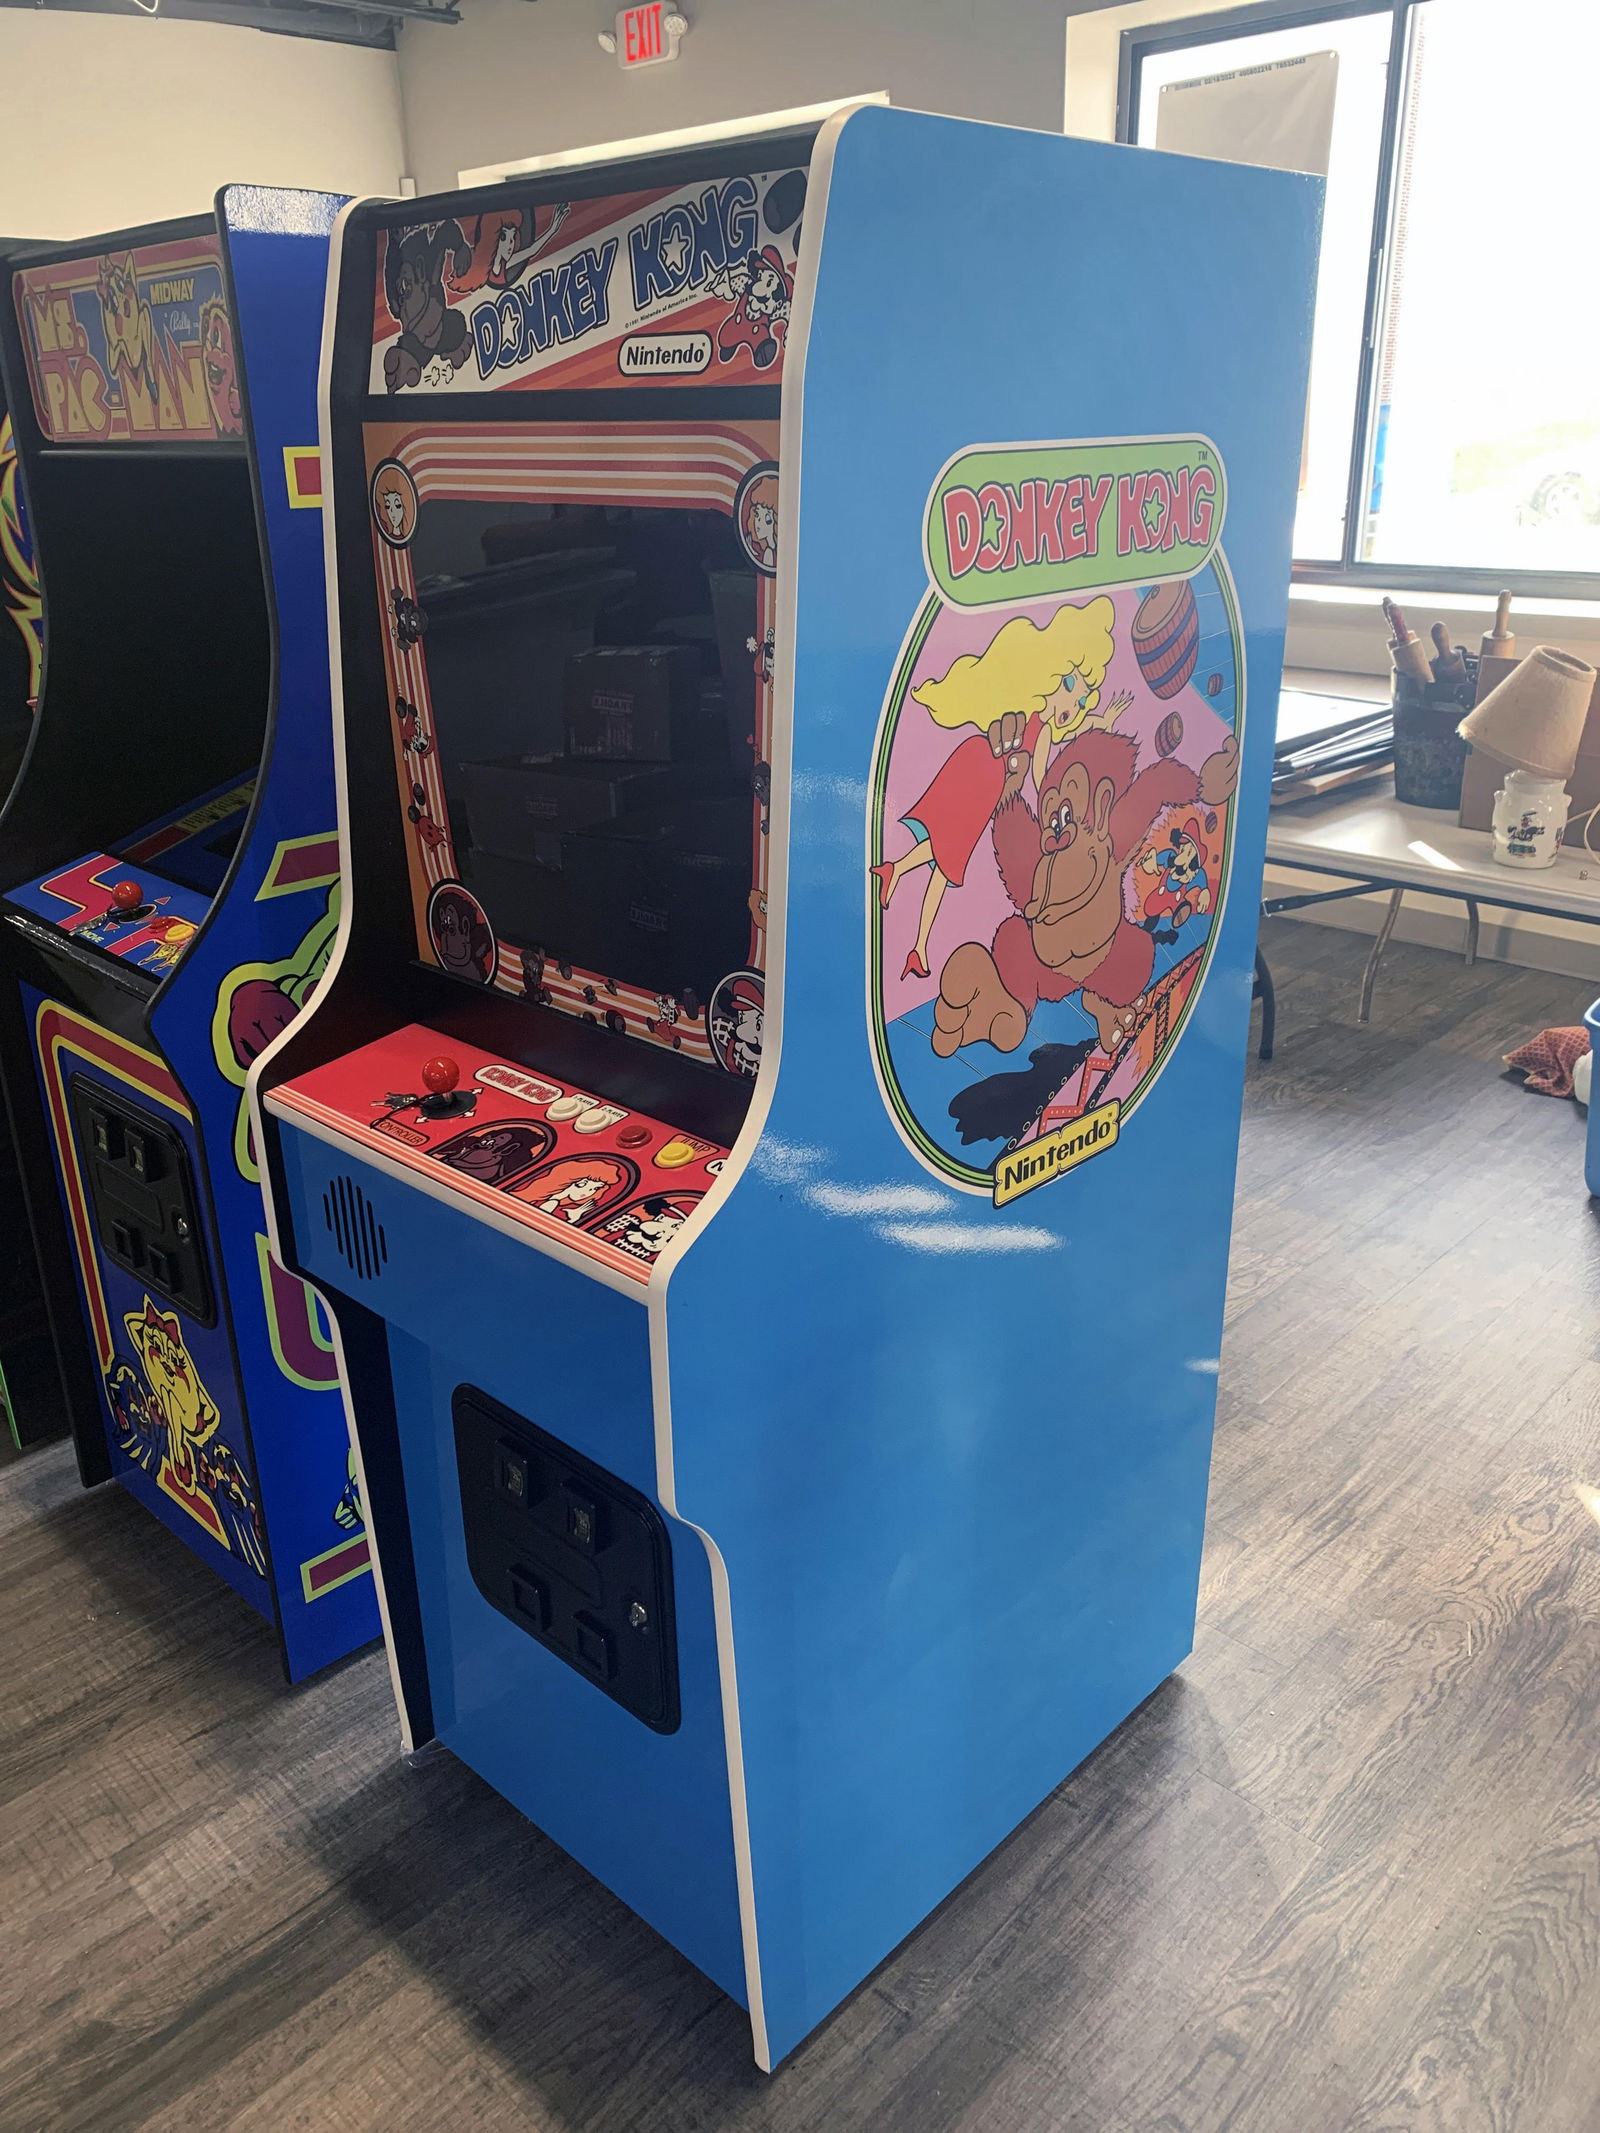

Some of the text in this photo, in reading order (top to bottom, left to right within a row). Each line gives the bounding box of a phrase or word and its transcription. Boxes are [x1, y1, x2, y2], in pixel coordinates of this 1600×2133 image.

[624, 4, 662, 62] EXIT
[149, 278, 195, 306] MIDWAY
[471, 236, 618, 380] DONKEY
[628, 176, 757, 311] KONG
[626, 342, 705, 366] Nintendo
[44, 352, 211, 434] PAC-MAN
[941, 475, 1114, 580] DONKEY
[1117, 464, 1217, 557] KONG
[378, 1121, 424, 1145] ONTROLLER
[1004, 1118, 1111, 1191] Nintendo
